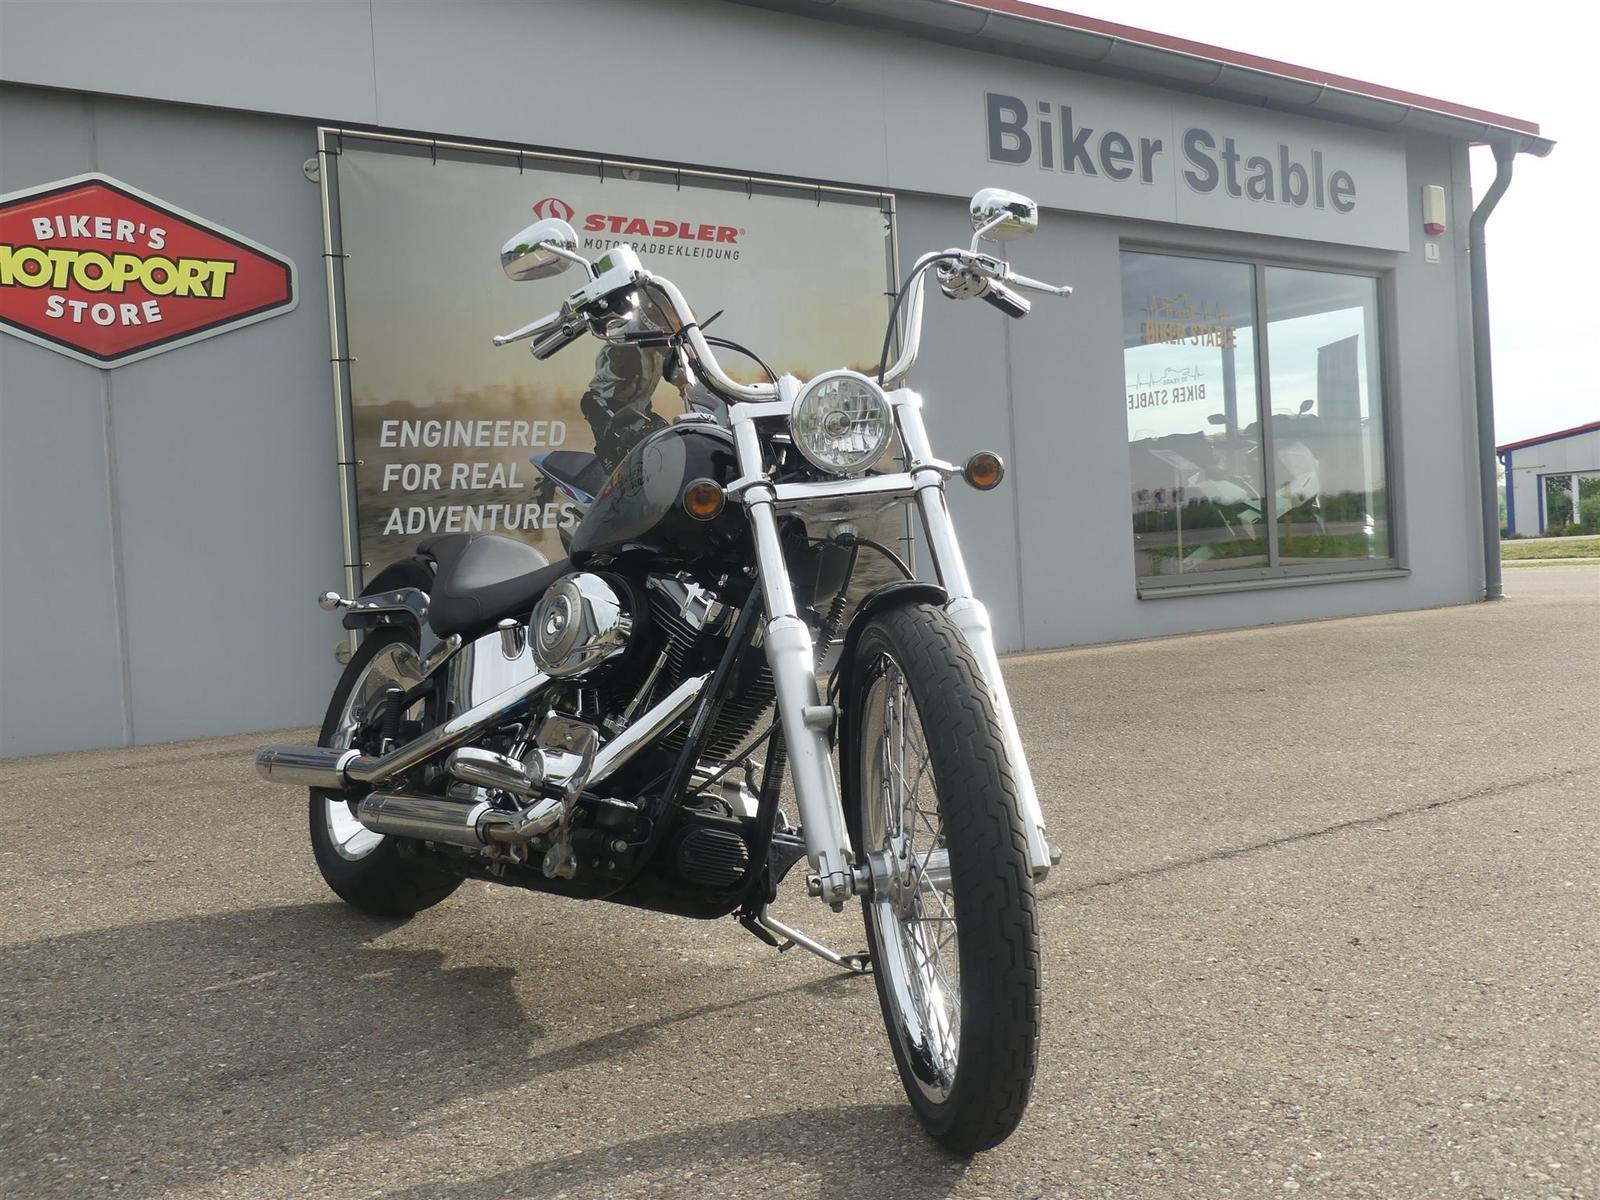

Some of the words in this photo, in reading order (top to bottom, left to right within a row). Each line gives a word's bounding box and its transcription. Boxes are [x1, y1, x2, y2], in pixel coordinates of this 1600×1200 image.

[985, 91, 1163, 185] Biker
[1181, 127, 1357, 214] Stable
[31, 215, 167, 250] BIKER'S
[583, 213, 739, 244] STADLER
[584, 237, 741, 261] MOTORADBEKLEIDUNG
[45, 295, 163, 326] STORE
[379, 420, 567, 448] ENGINEERED
[382, 463, 443, 492] FOR
[450, 462, 525, 491] REAL
